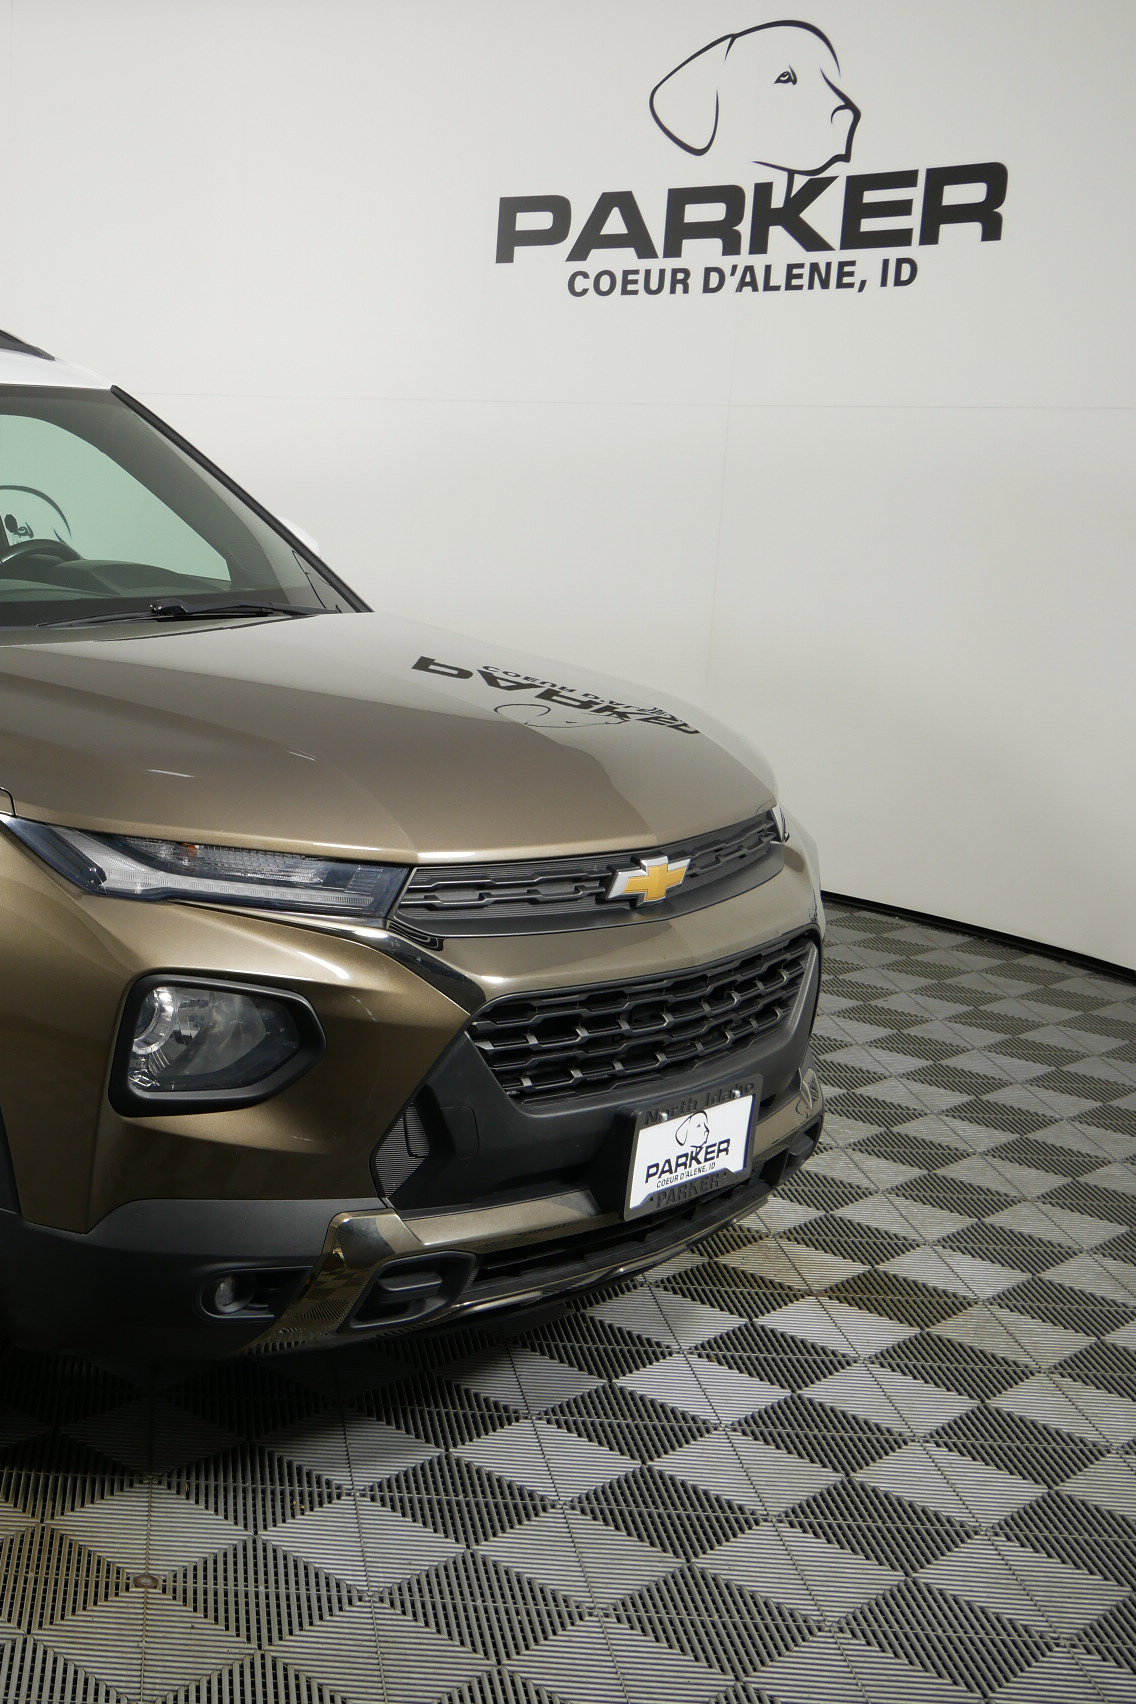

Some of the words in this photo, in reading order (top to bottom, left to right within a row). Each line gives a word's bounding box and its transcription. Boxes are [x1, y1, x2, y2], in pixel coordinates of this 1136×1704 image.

[496, 162, 1008, 263] PARKER
[567, 267, 691, 297] COEUR
[702, 260, 867, 294] D'ALENE,
[879, 258, 918, 288] ID
[644, 1138, 731, 1185] PARKER
[656, 1174, 680, 1189] COEUR
[679, 1165, 709, 1181] D'ALENE,
[709, 1161, 717, 1171] ID
[656, 1173, 720, 1209] PARKER
